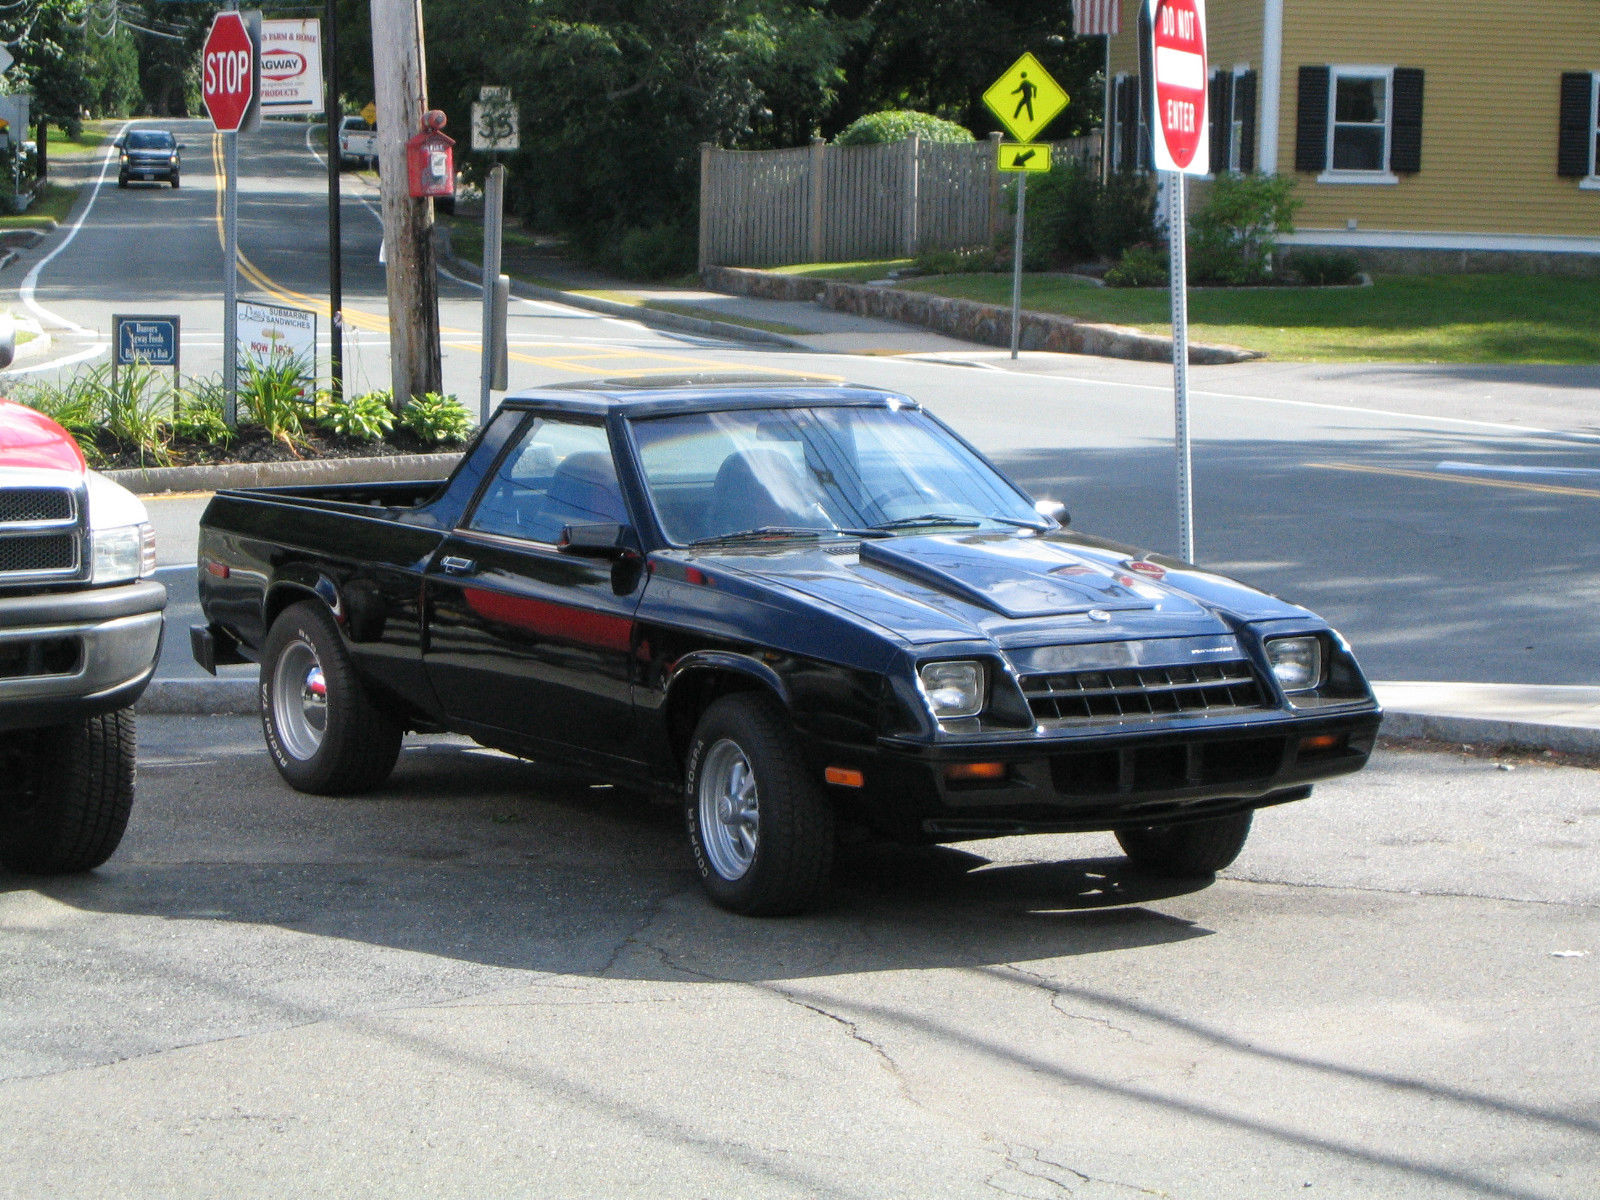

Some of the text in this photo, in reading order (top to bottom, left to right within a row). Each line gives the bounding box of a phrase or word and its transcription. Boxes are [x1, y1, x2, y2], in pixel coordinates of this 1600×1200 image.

[1162, 4, 1194, 40] DO NOT
[206, 50, 249, 95] STOP
[480, 112, 513, 138] 35
[1167, 98, 1195, 133] ENTER
[265, 316, 311, 330] SANDWICHES
[269, 307, 309, 321] SUBMARINE
[250, 341, 268, 353] NOW
